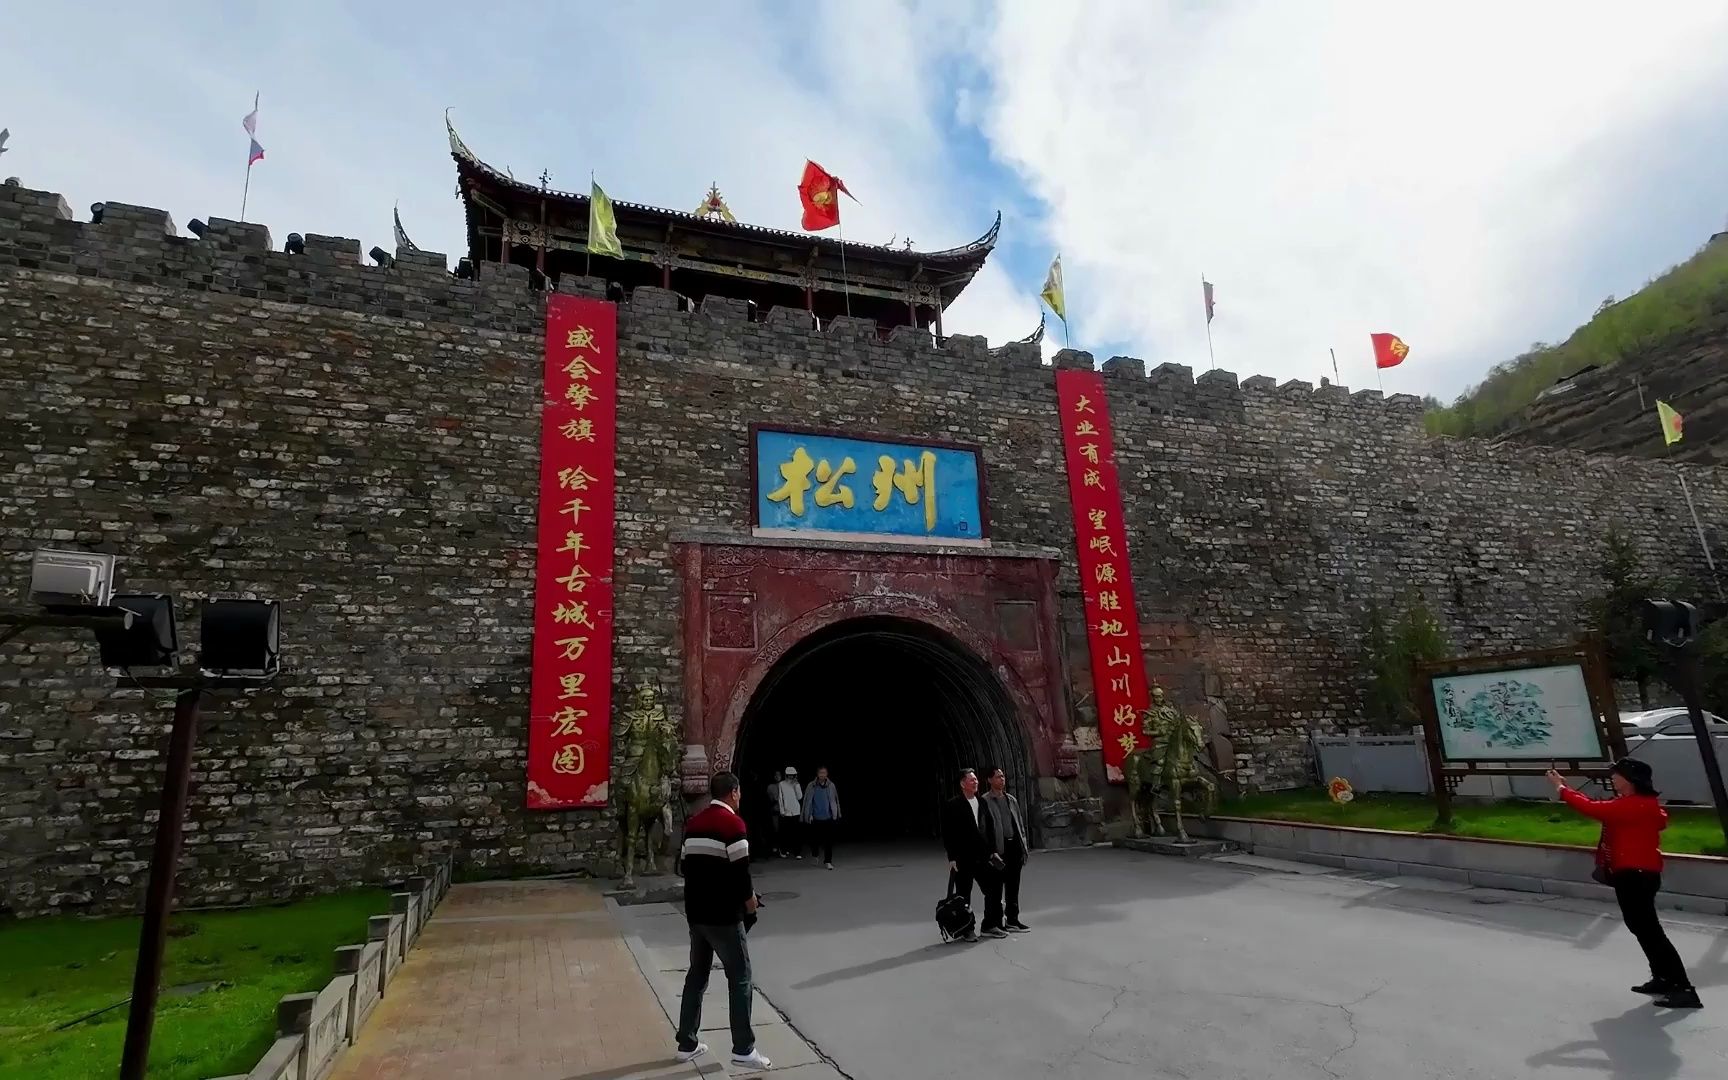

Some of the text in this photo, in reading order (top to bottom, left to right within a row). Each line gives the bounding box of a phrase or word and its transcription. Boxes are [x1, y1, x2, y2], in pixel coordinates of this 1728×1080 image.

[550, 324, 602, 775] 盛会擎旗 绘千年古城万里宏图
[766, 447, 937, 531] 松州
[1074, 394, 1139, 759] 大业有成 望岷源胜地山川好梦
